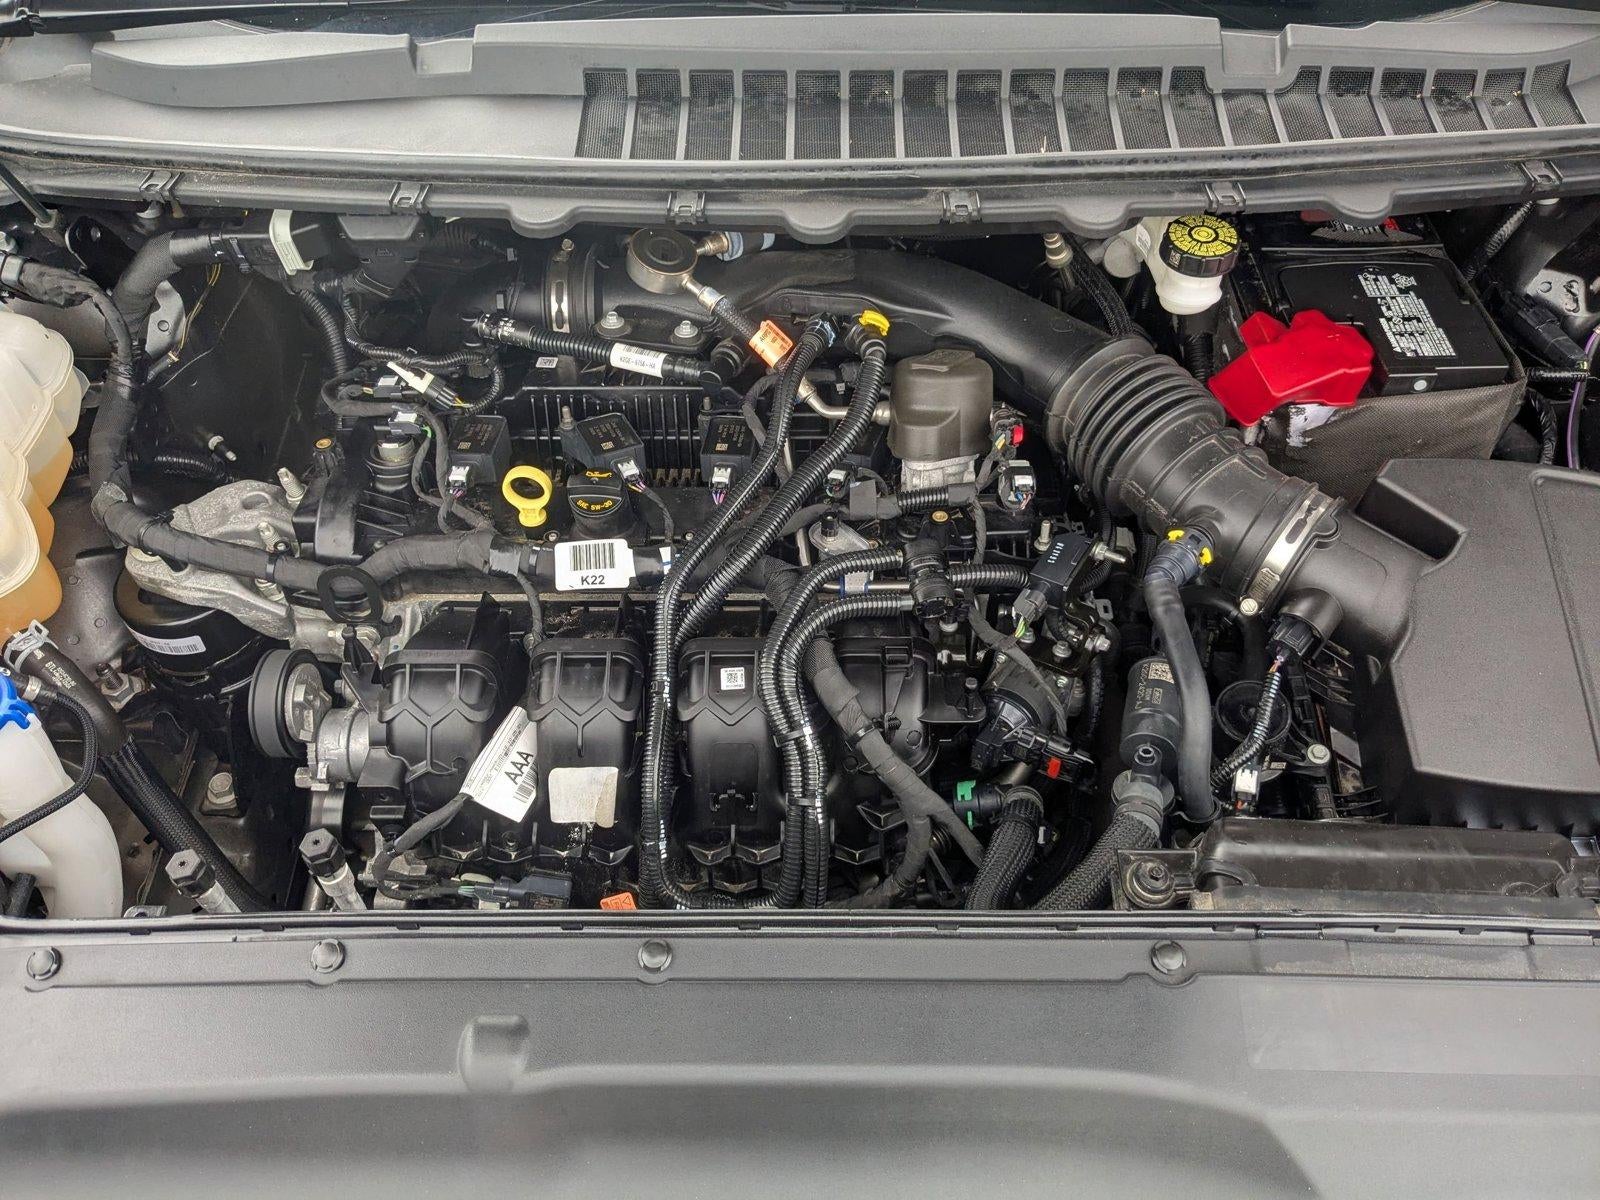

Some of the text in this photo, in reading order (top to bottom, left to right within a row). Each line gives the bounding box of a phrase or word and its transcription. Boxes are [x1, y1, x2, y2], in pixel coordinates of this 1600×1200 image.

[576, 499, 613, 511] SAE 5W-30
[581, 575, 606, 586] K22
[504, 751, 534, 785] AAA
